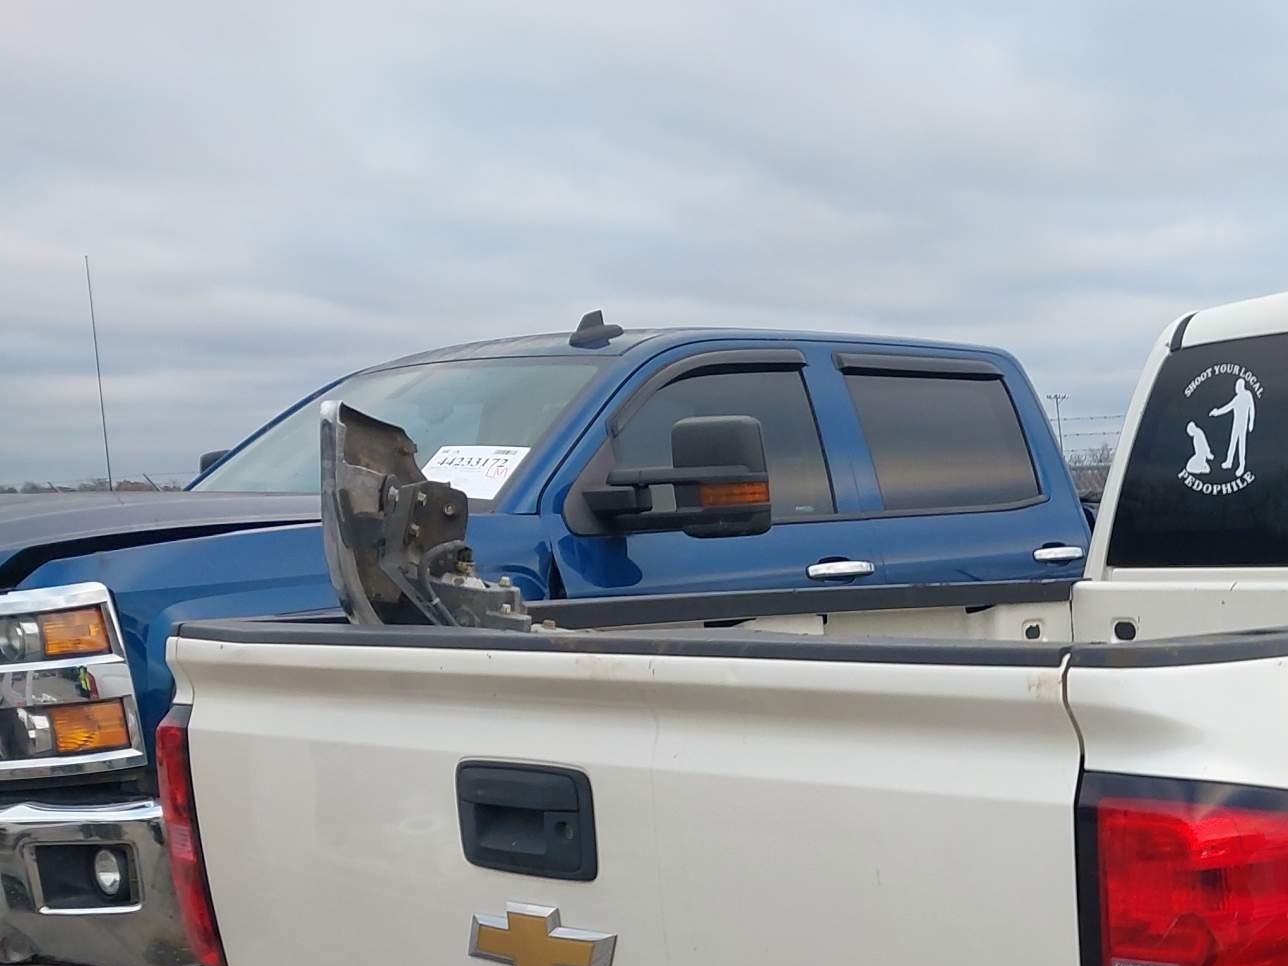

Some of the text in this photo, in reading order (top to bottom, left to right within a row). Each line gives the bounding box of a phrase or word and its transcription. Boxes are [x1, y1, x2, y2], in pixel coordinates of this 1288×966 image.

[1184, 363, 1264, 399] SHOOT YOUR LOCAL
[437, 456, 509, 468] 44233172
[1177, 468, 1256, 496] PEDOPHILE
